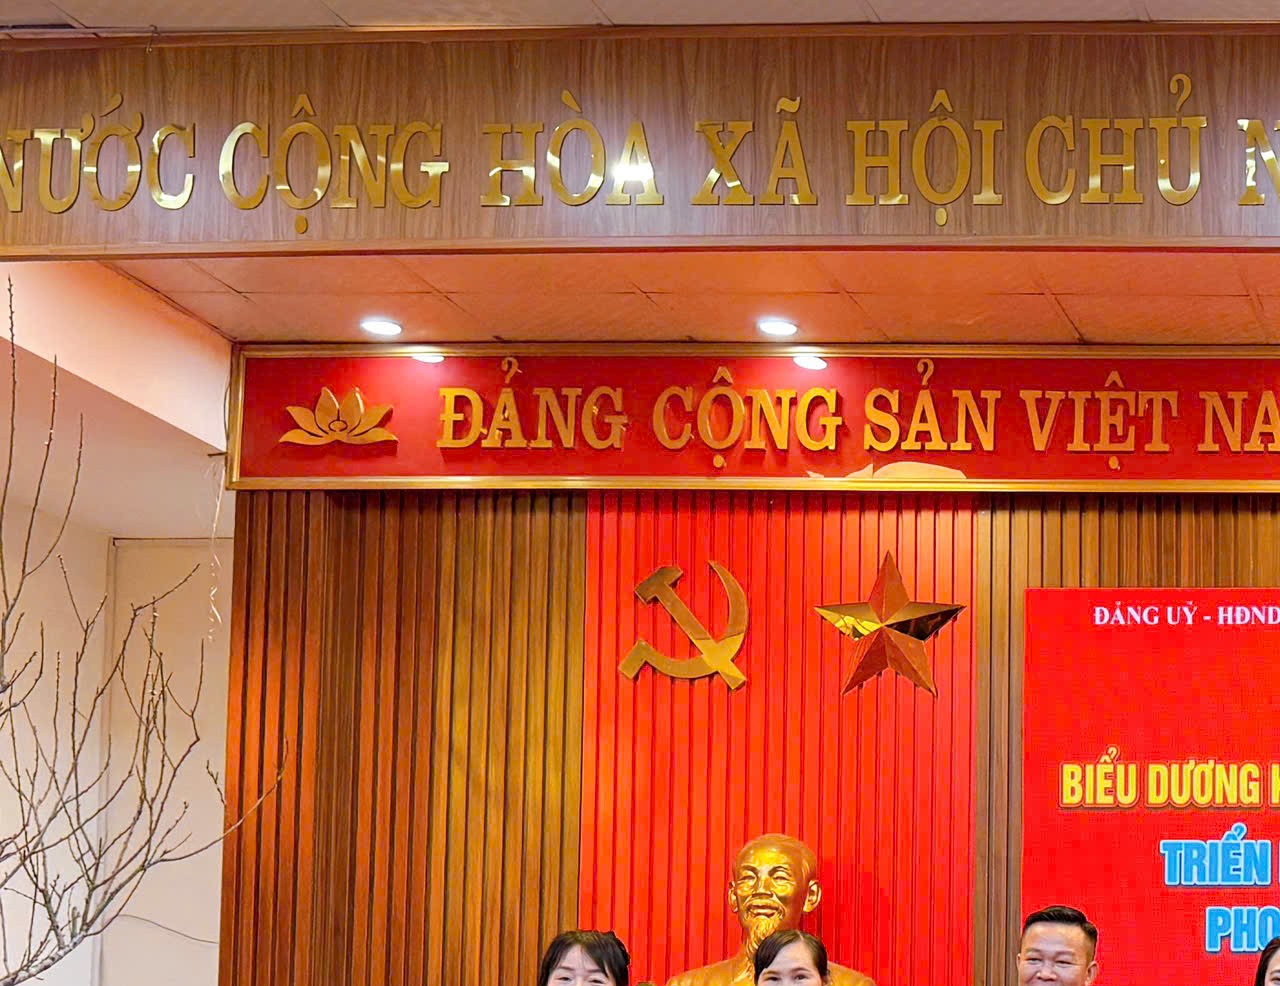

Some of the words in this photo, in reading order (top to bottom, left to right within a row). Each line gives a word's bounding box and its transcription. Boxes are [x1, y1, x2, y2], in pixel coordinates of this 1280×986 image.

[218, 93, 450, 234] CỘNG
[480, 90, 666, 206] HÒA
[691, 96, 819, 206] XÃ
[845, 89, 1004, 227] HỘI
[1024, 73, 1207, 206] CHỦ
[436, 357, 628, 449] ĐẢNG
[652, 365, 842, 469] CỘNG
[863, 358, 1002, 452] SẢN
[1019, 370, 1179, 471] VIỆT
[1093, 600, 1160, 625] ĐẢNG
[1061, 747, 1138, 806] BIỂU
[1147, 759, 1260, 806] DƯƠNG
[1160, 823, 1271, 886] TRIỂN
